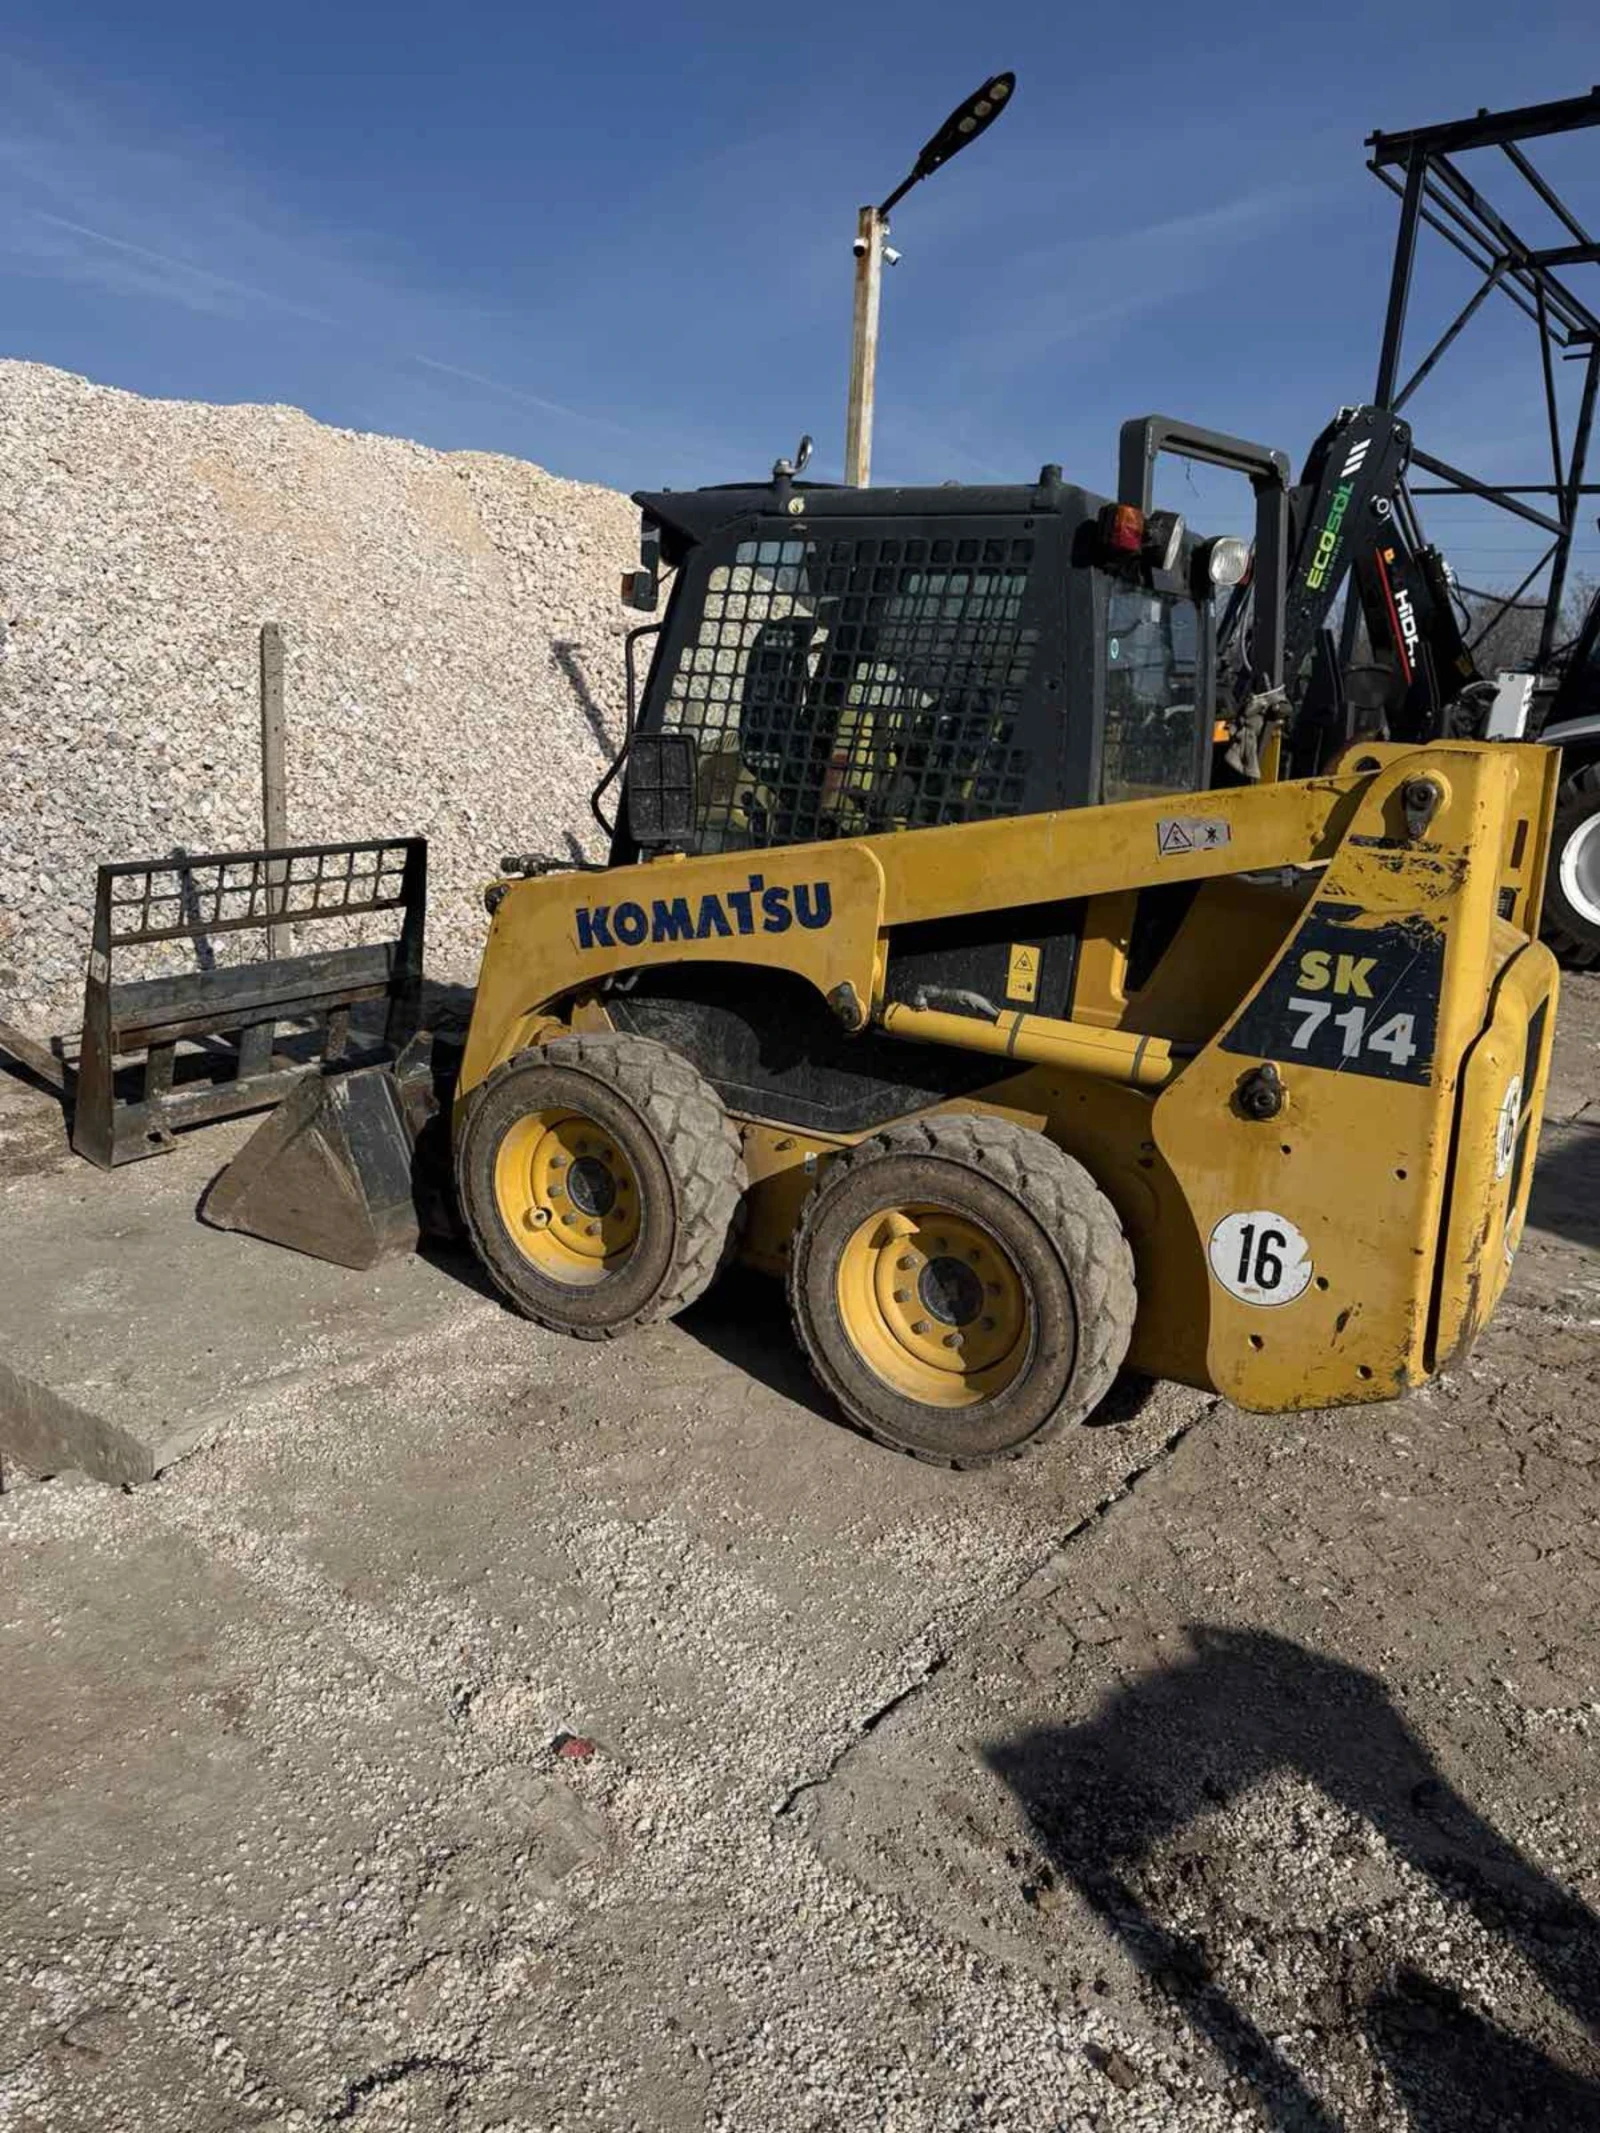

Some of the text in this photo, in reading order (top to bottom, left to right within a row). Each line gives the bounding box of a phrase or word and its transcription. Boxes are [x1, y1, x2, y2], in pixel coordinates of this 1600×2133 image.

[1306, 481, 1355, 589] ECOSOL
[575, 874, 832, 949] KOMATSU
[1296, 950, 1378, 998] SK
[1288, 997, 1417, 1067] 714
[1237, 1223, 1287, 1290] 16
